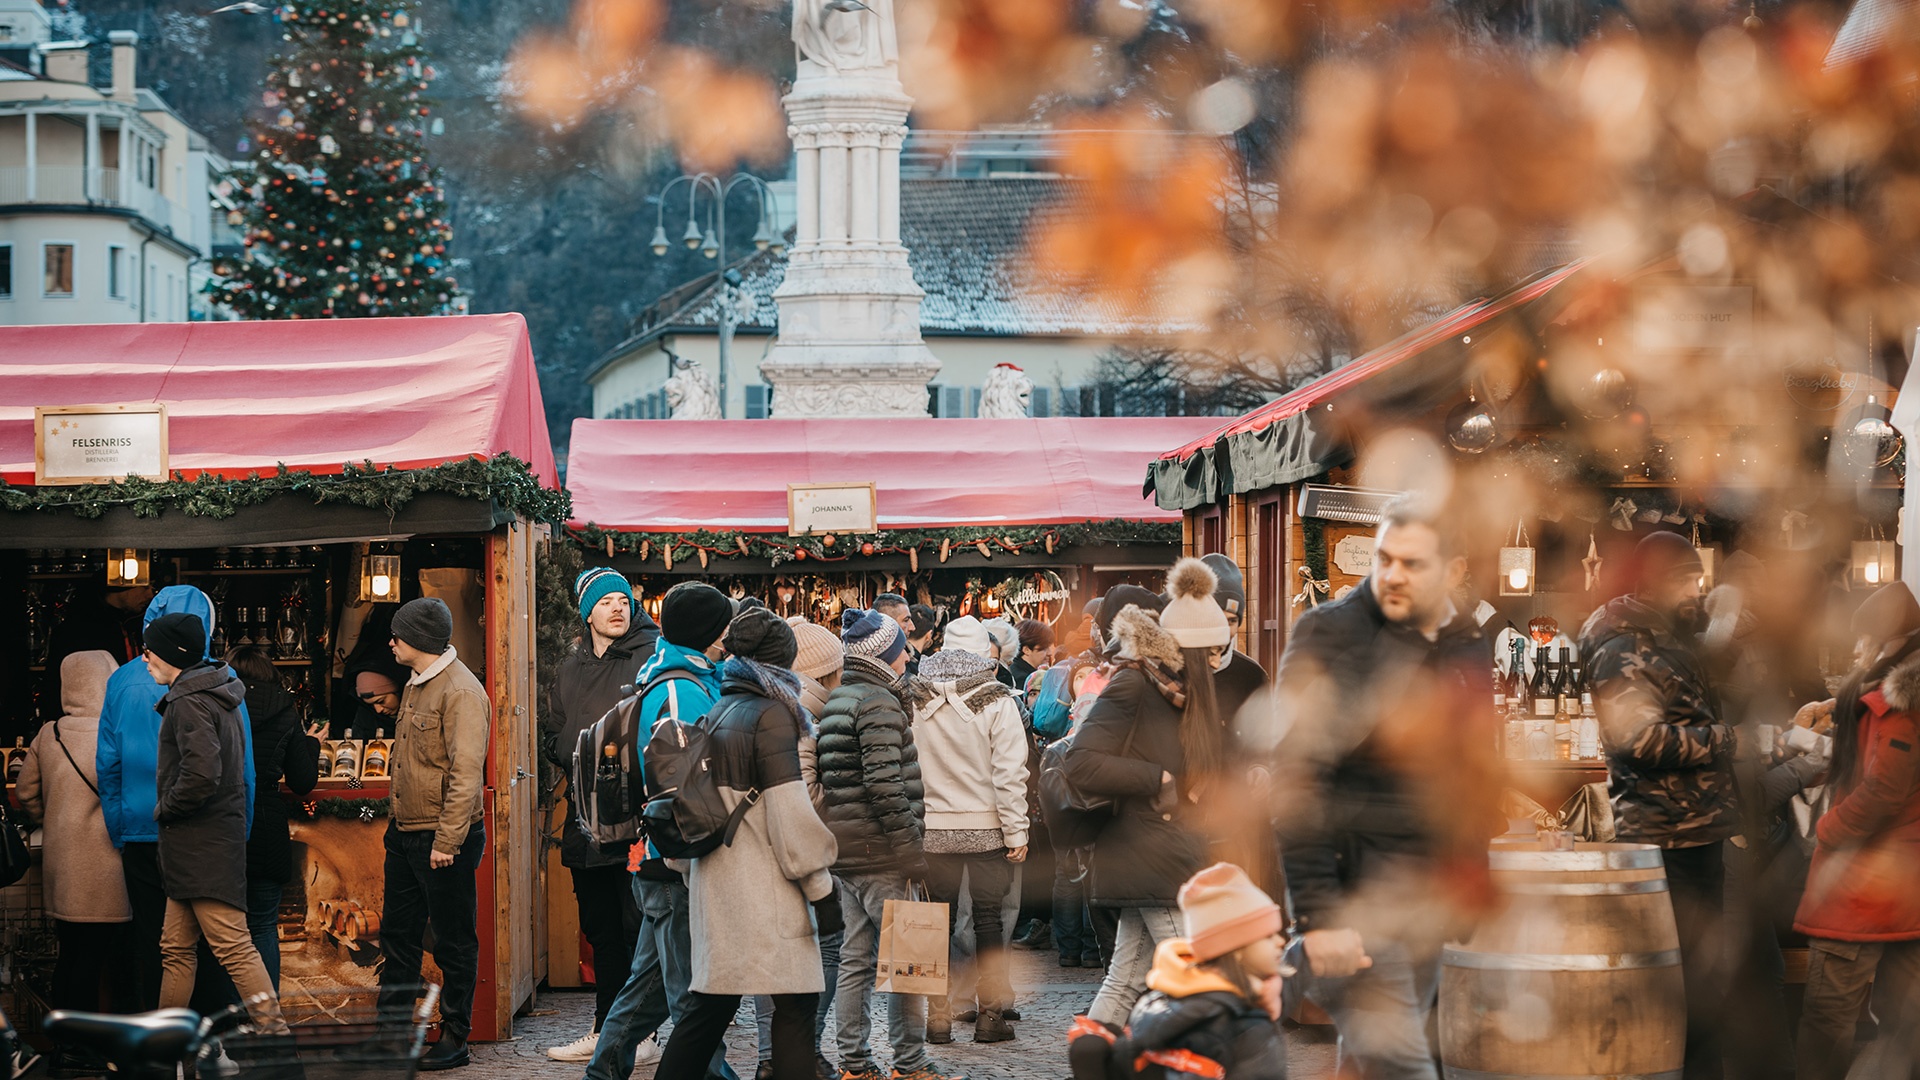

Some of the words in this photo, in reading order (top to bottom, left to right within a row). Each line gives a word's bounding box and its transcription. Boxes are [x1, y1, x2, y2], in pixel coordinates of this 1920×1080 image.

[1710, 313, 1732, 322] HUT
[72, 438, 132, 448] FELSENRISS
[812, 505, 853, 514] JOHANNA'S
[1530, 624, 1555, 632] WECK
